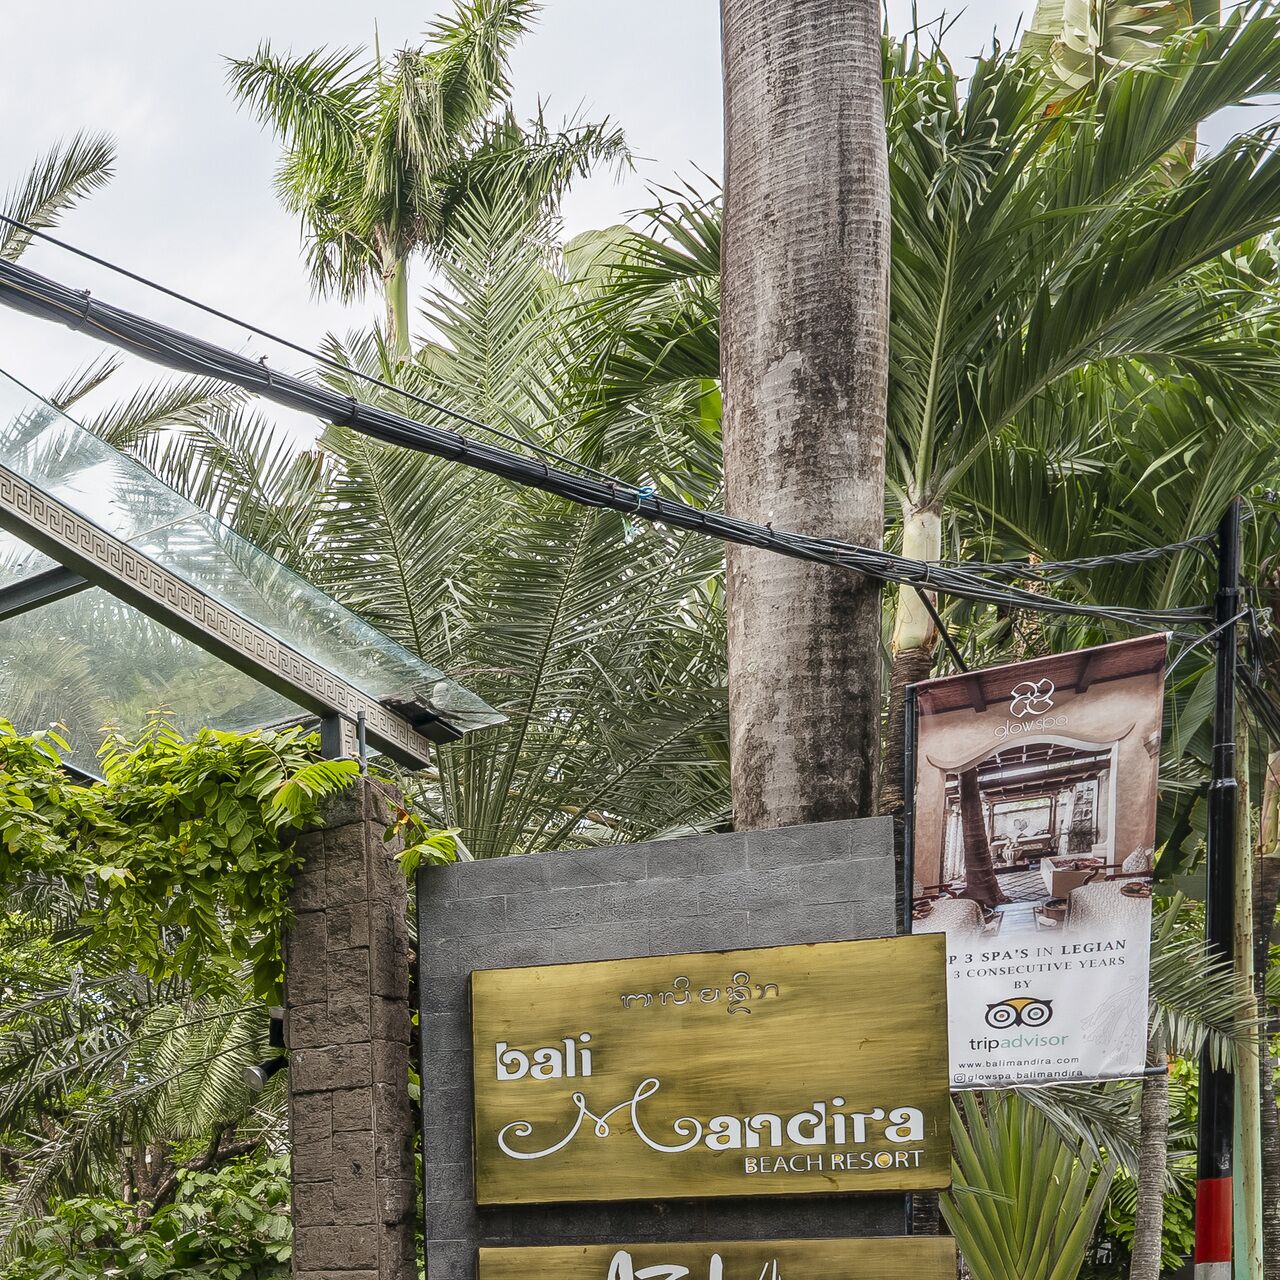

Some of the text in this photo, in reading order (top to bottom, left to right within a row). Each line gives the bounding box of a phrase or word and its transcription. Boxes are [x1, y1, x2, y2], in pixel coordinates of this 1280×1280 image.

[964, 953, 973, 963] 3
[981, 948, 1029, 962] SPA'S
[1037, 947, 1053, 957] IN
[1061, 939, 1127, 955] LEGIAN
[953, 956, 1126, 979] 3 CONSECUTIVE YEARS
[1013, 980, 1032, 989] BY
[968, 1034, 1069, 1053] tripadvisor
[496, 1032, 593, 1082] bali
[497, 1078, 925, 1160] Mandira
[744, 1150, 924, 1174] BEACH RESORT
